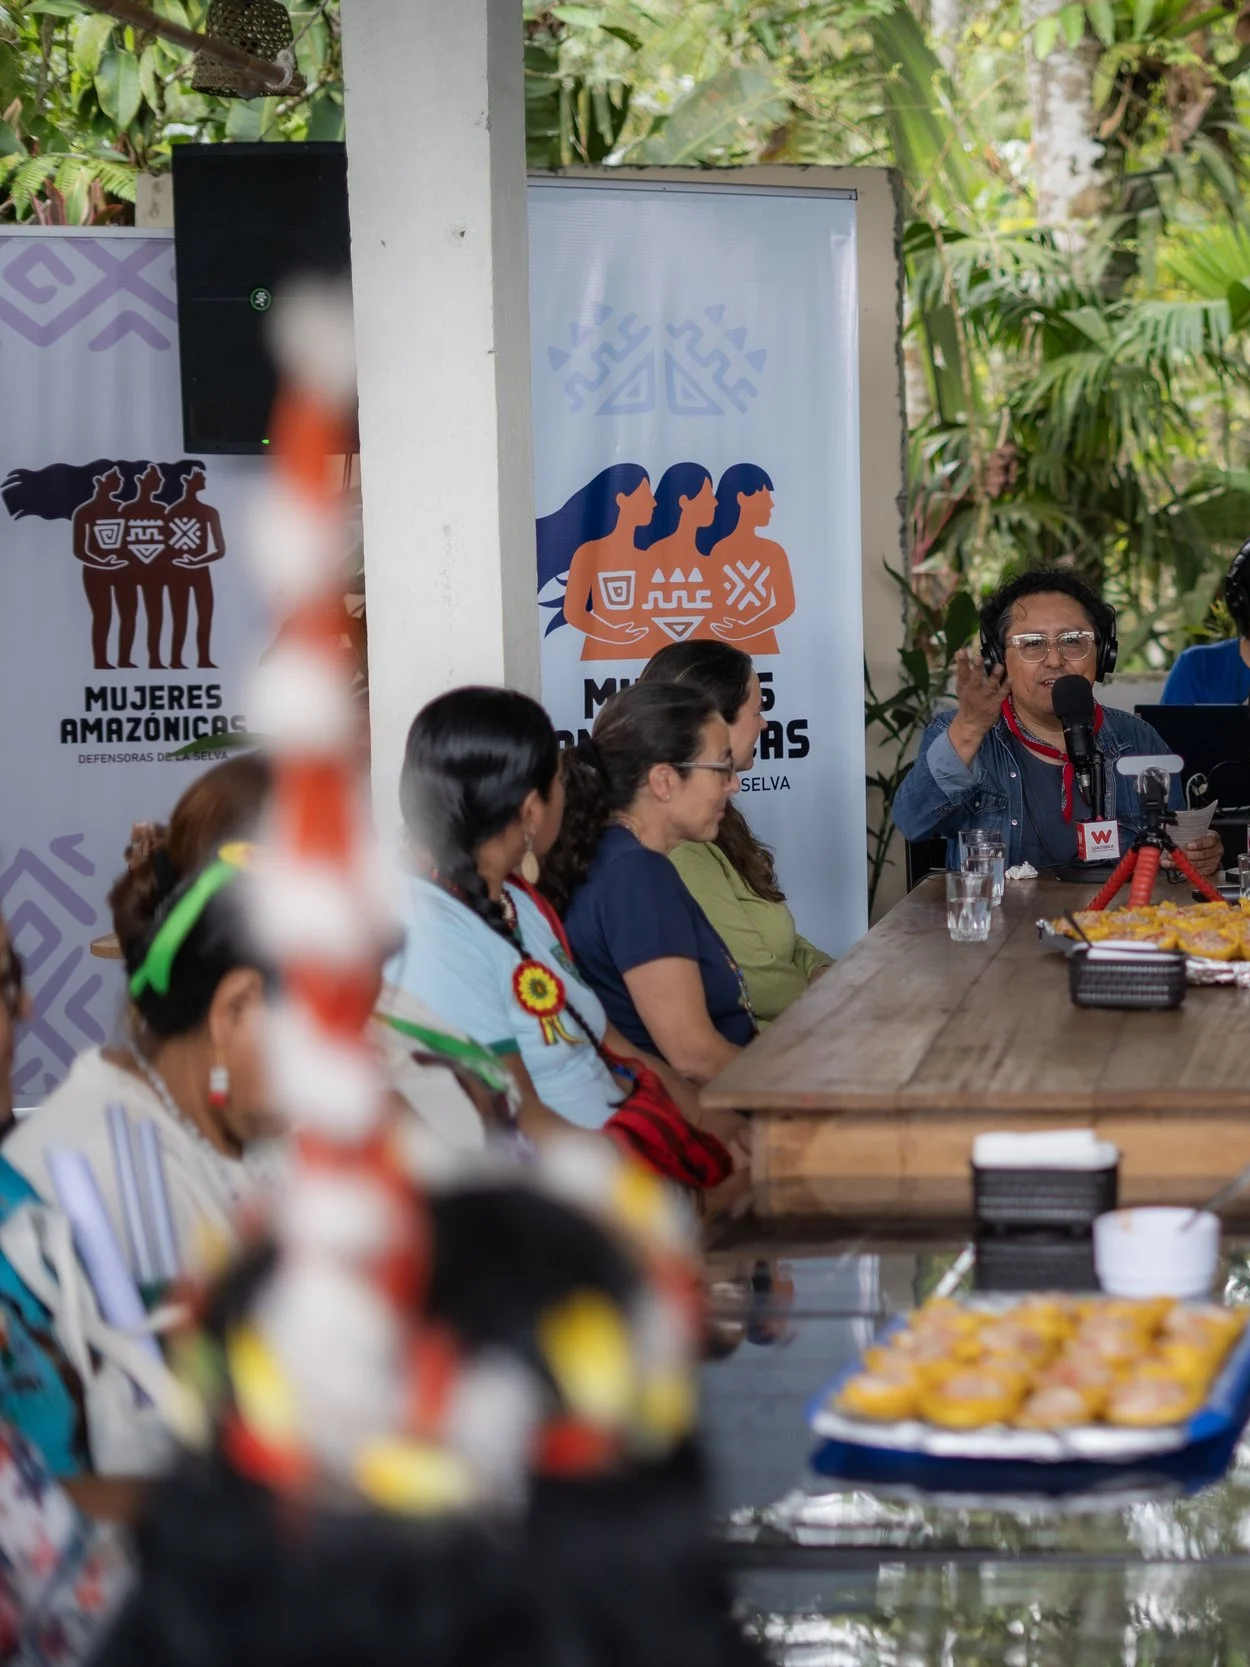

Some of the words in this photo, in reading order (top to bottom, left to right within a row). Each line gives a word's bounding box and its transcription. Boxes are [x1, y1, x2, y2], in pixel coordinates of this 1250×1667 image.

[84, 684, 223, 712] MUJERES
[60, 712, 249, 744] AMAZÓNICAS
[78, 752, 154, 764] DEFENSORAS
[157, 752, 173, 762] DE
[740, 776, 791, 792] SELVA
